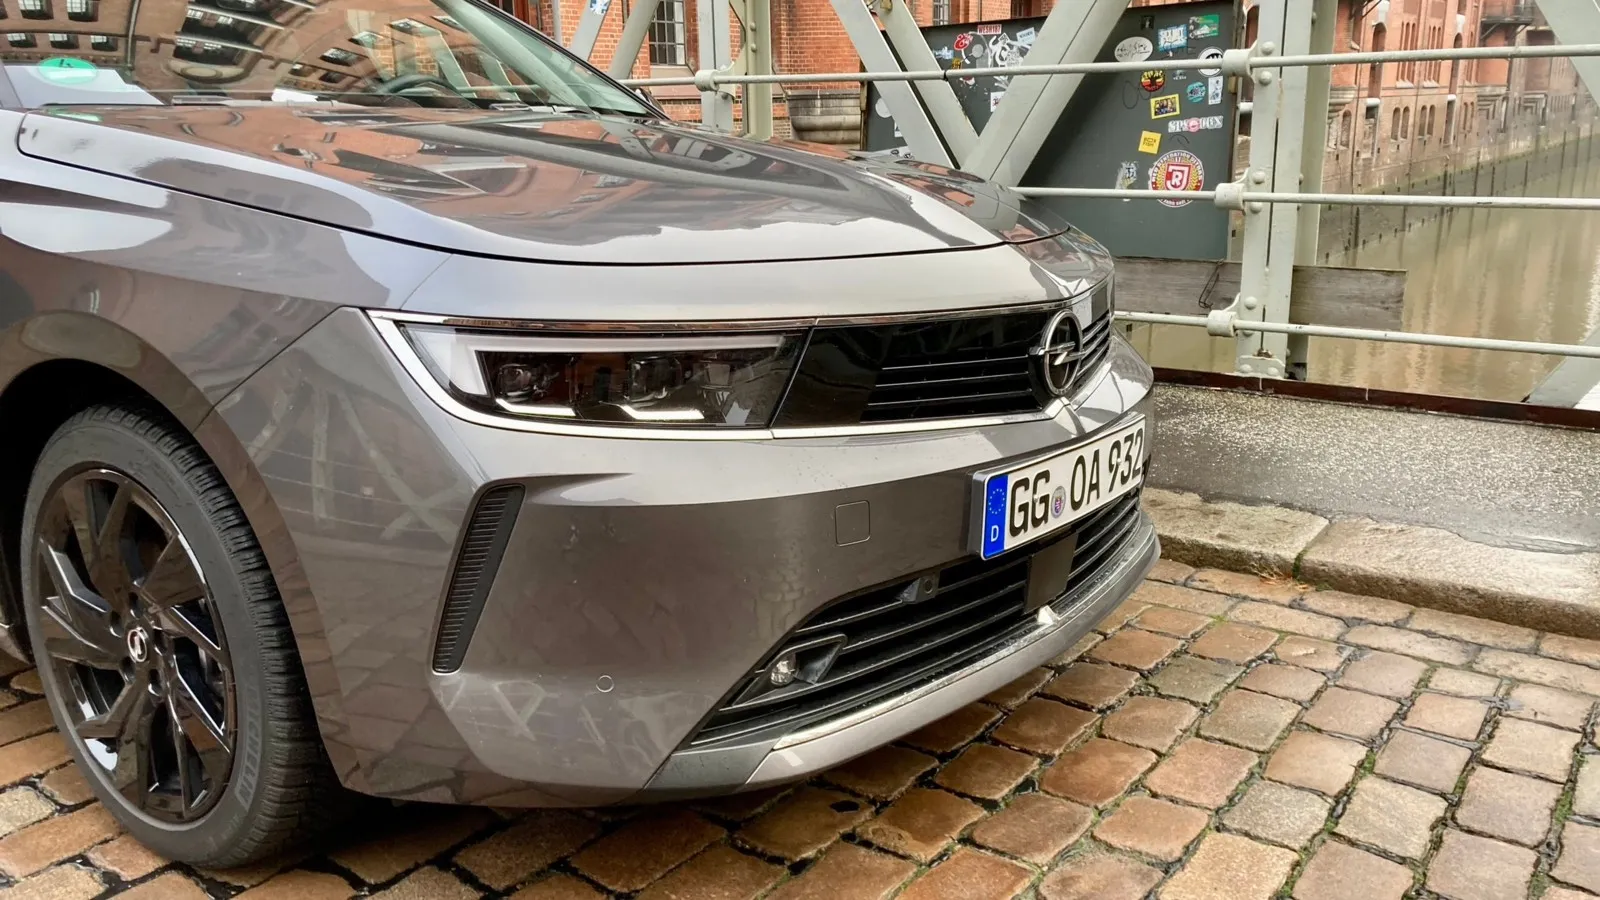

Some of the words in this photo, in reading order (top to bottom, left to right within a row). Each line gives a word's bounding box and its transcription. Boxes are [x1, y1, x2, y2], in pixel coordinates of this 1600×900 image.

[1009, 468, 1051, 538] GG
[1070, 448, 1101, 512] OA
[1108, 427, 1144, 493] 932
[990, 524, 999, 543] D
